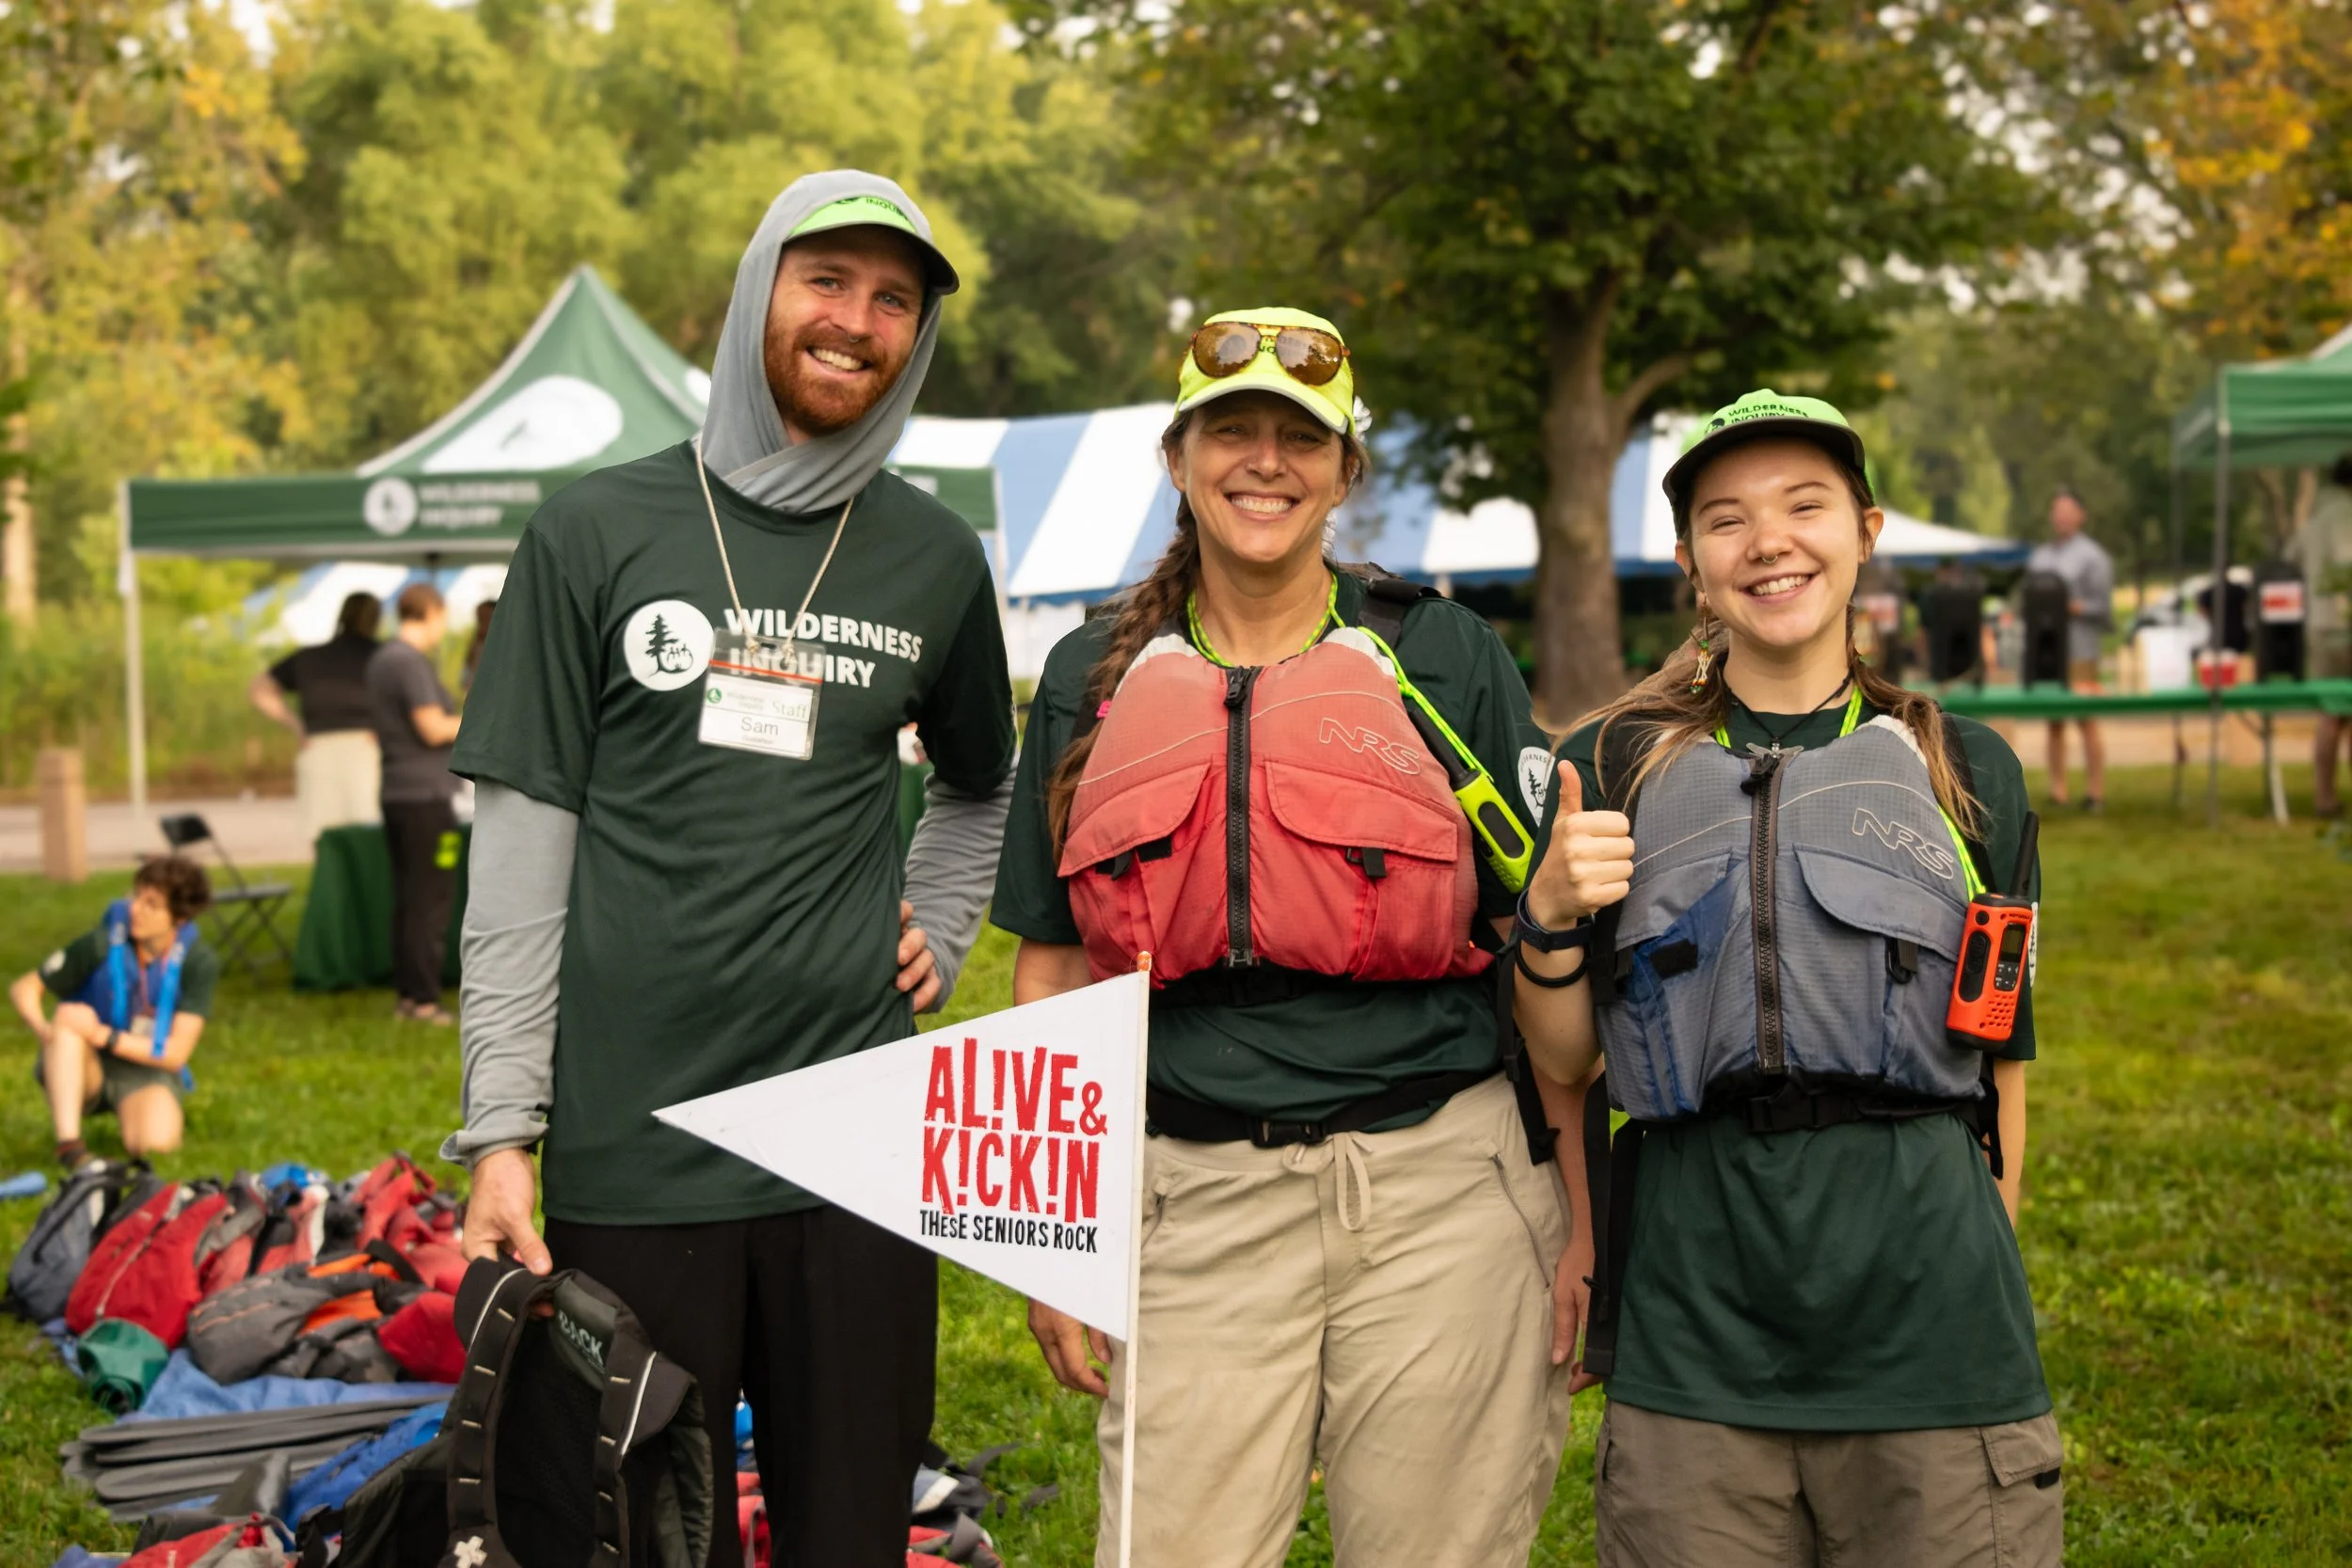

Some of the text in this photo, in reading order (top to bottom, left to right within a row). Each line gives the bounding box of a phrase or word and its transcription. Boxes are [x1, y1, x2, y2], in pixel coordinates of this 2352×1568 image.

[723, 609, 923, 663] WILDERNESS
[741, 717, 779, 736] Sam
[771, 701, 808, 719] Staff
[1319, 717, 1422, 775] NRS
[1851, 807, 1954, 879] NRS
[973, 1214, 1049, 1248] SENIORS
